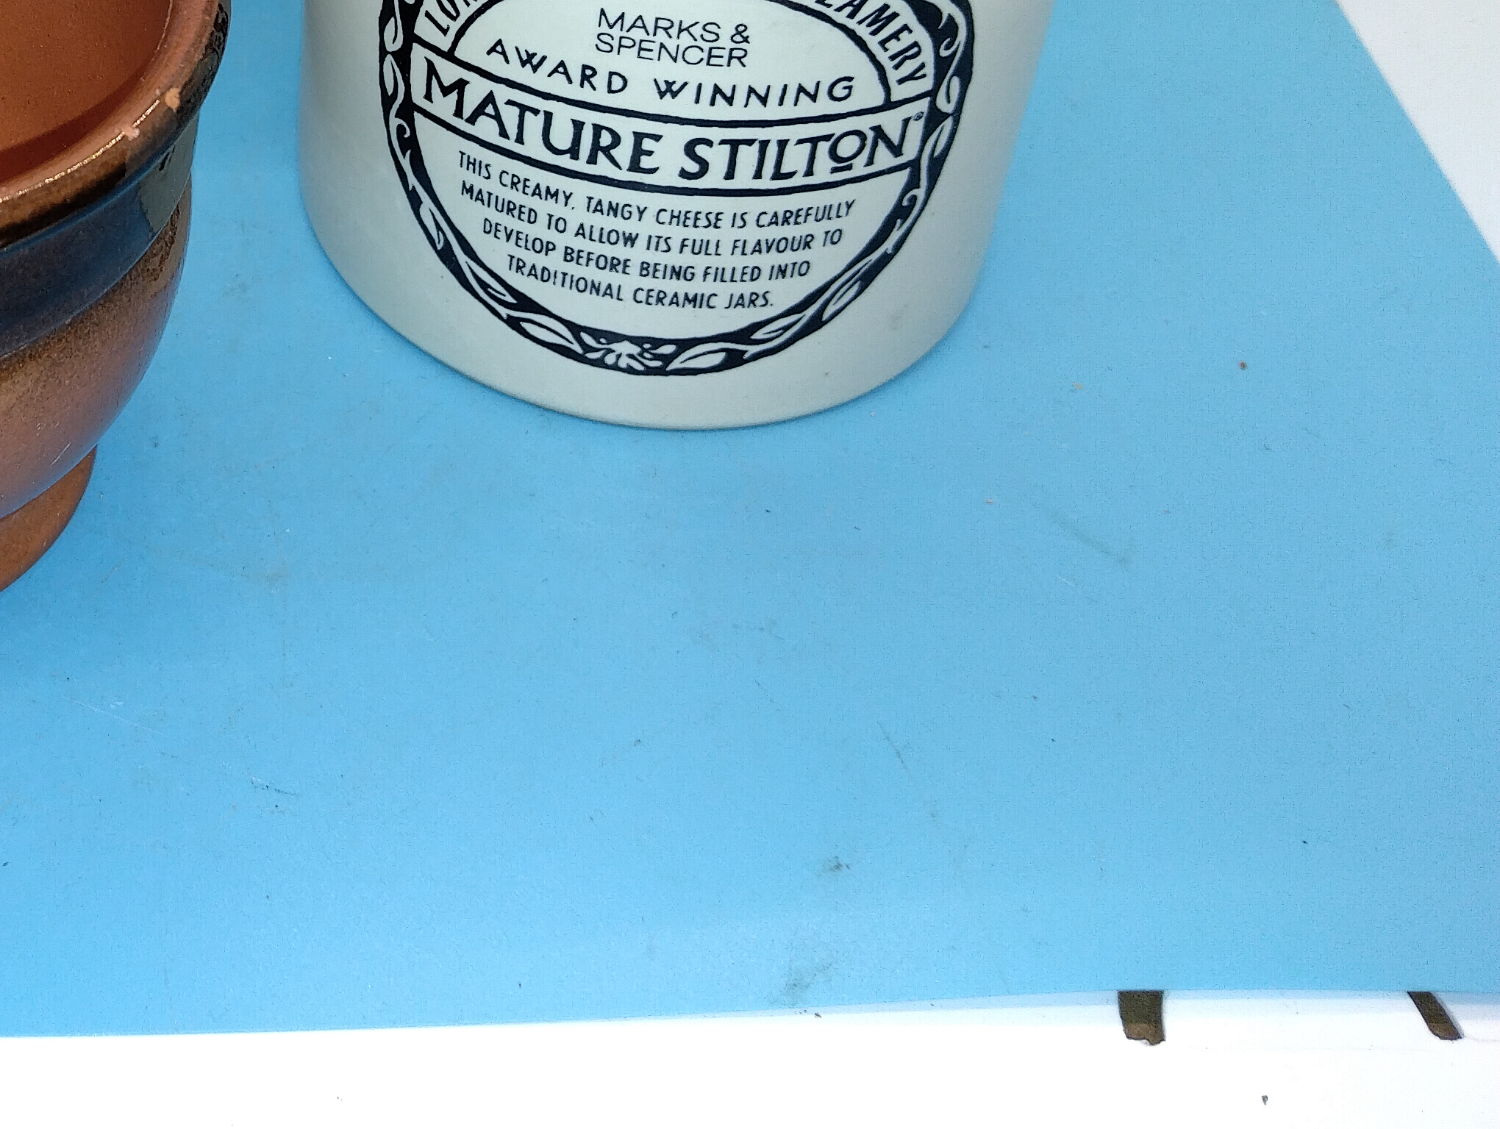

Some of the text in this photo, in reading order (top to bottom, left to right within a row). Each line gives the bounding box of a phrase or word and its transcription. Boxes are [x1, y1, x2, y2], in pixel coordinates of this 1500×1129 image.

[595, 32, 748, 67] SPENCER
[598, 8, 750, 45] MARKS &
[486, 39, 854, 108] AWARD WINNING
[423, 56, 664, 175] MATURE
[459, 151, 492, 180] THIS
[586, 196, 648, 222] TANGY
[656, 208, 724, 229] CHEESE
[731, 211, 748, 228] IS
[756, 199, 856, 228] CAREFULLY
[461, 180, 843, 256] MATURED TO ALLOW ITS FULL FLAVOUR TO
[483, 218, 811, 283] DEVELOP BEFORE BEING FILLED INTO
[507, 254, 774, 309] TRADITIONAL CERAMIC JARS.
